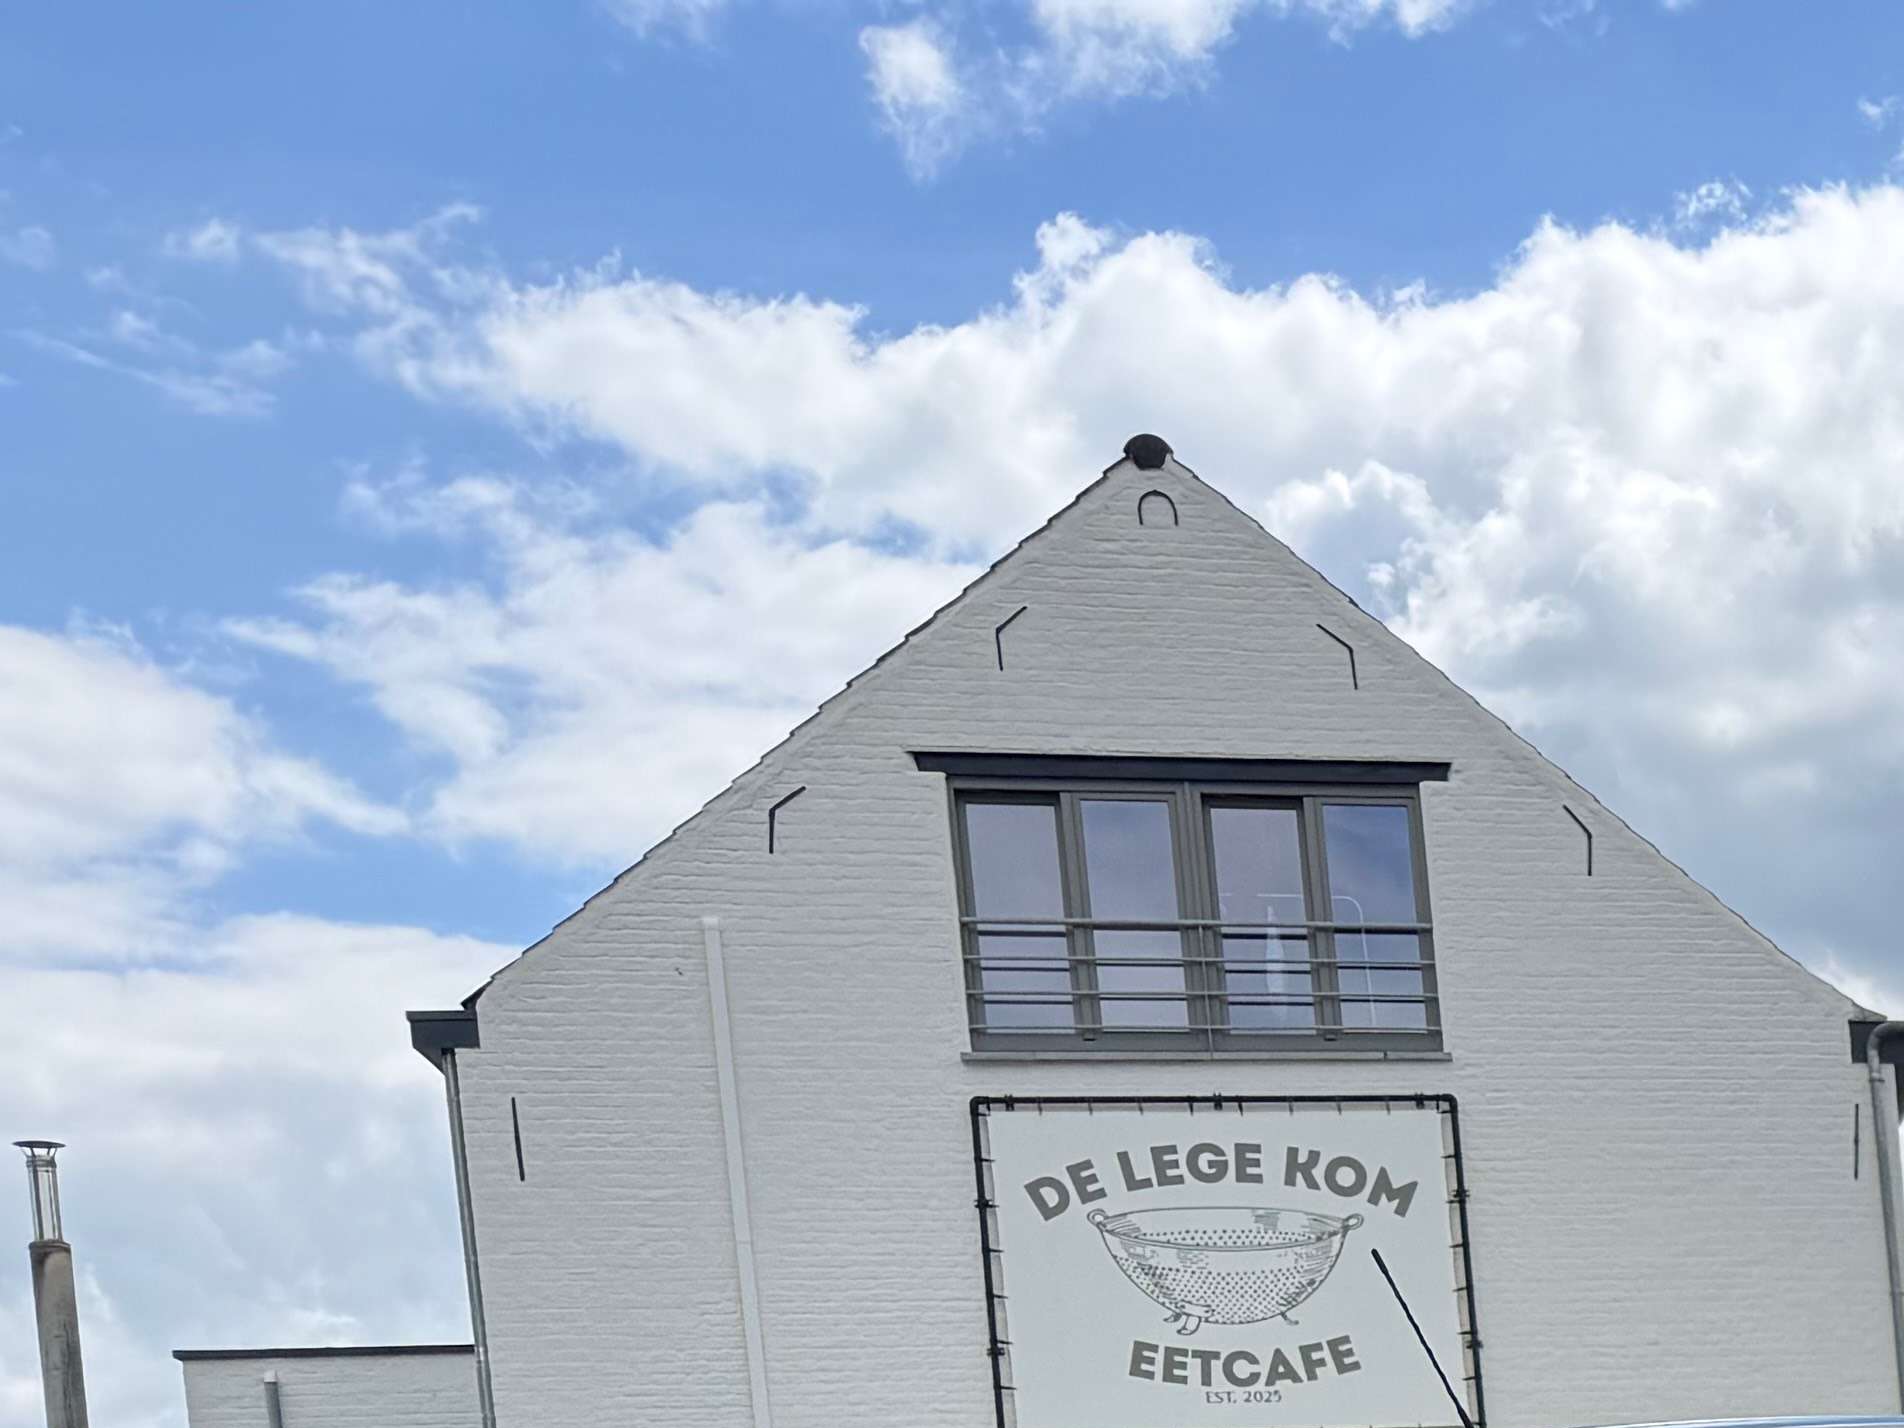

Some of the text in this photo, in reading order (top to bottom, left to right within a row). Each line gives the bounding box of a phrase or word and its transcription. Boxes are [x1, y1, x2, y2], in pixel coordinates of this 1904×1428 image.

[1023, 1142, 1419, 1222] DE LEGE KOM
[1128, 1335, 1362, 1389] EETCAFE
[1205, 1391, 1237, 1403] EST.
